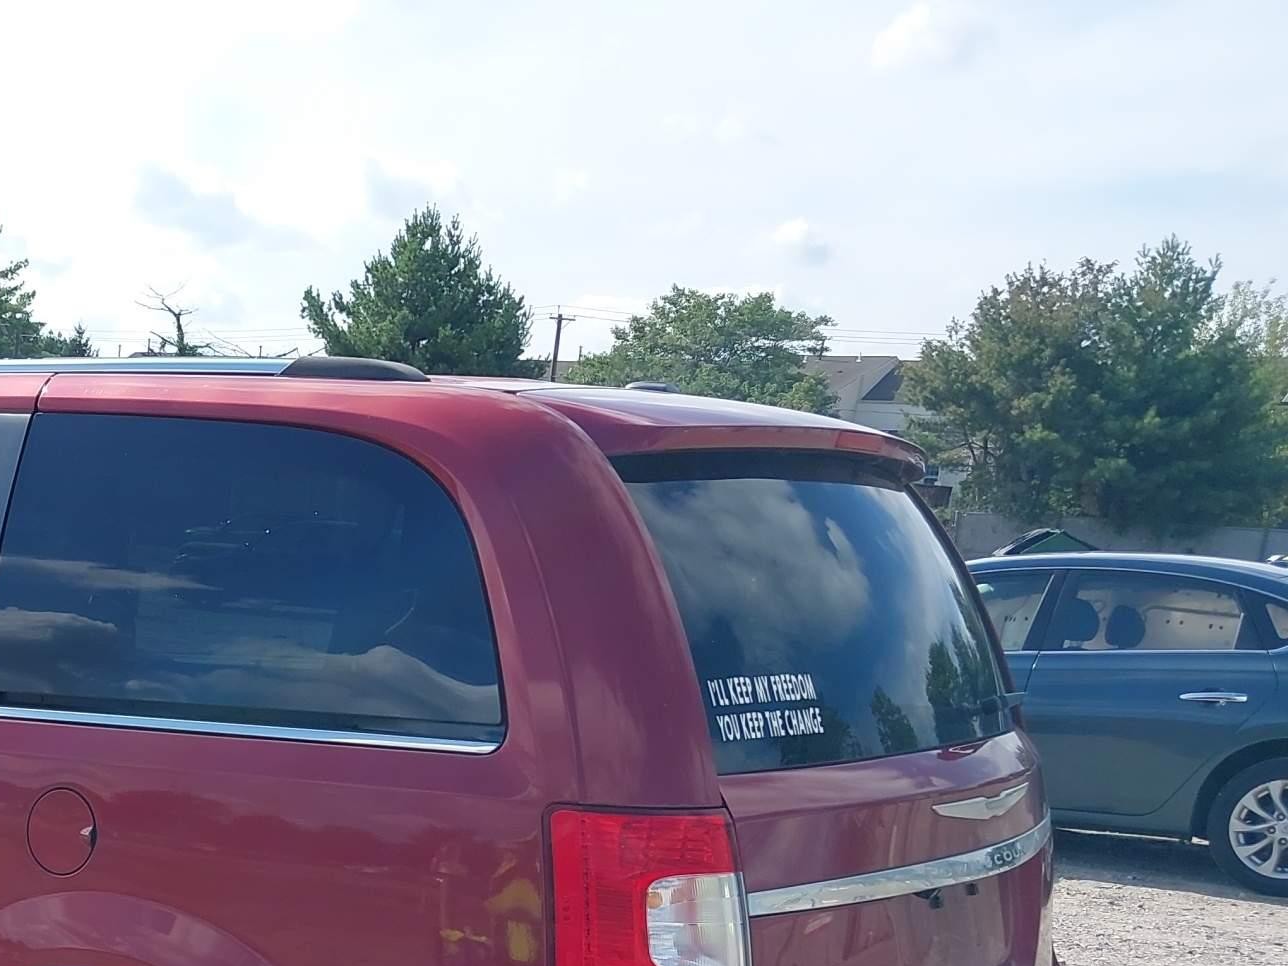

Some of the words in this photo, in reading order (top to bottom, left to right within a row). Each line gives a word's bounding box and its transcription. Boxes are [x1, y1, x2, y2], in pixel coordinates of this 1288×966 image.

[707, 679, 730, 706] I'LL
[727, 677, 753, 705] KEEP
[754, 676, 771, 703] MY
[770, 674, 816, 702] FREEDOM
[716, 715, 741, 741] YOU
[740, 712, 764, 740] KEEP
[765, 710, 786, 737] THE
[784, 707, 824, 736] CHANGE
